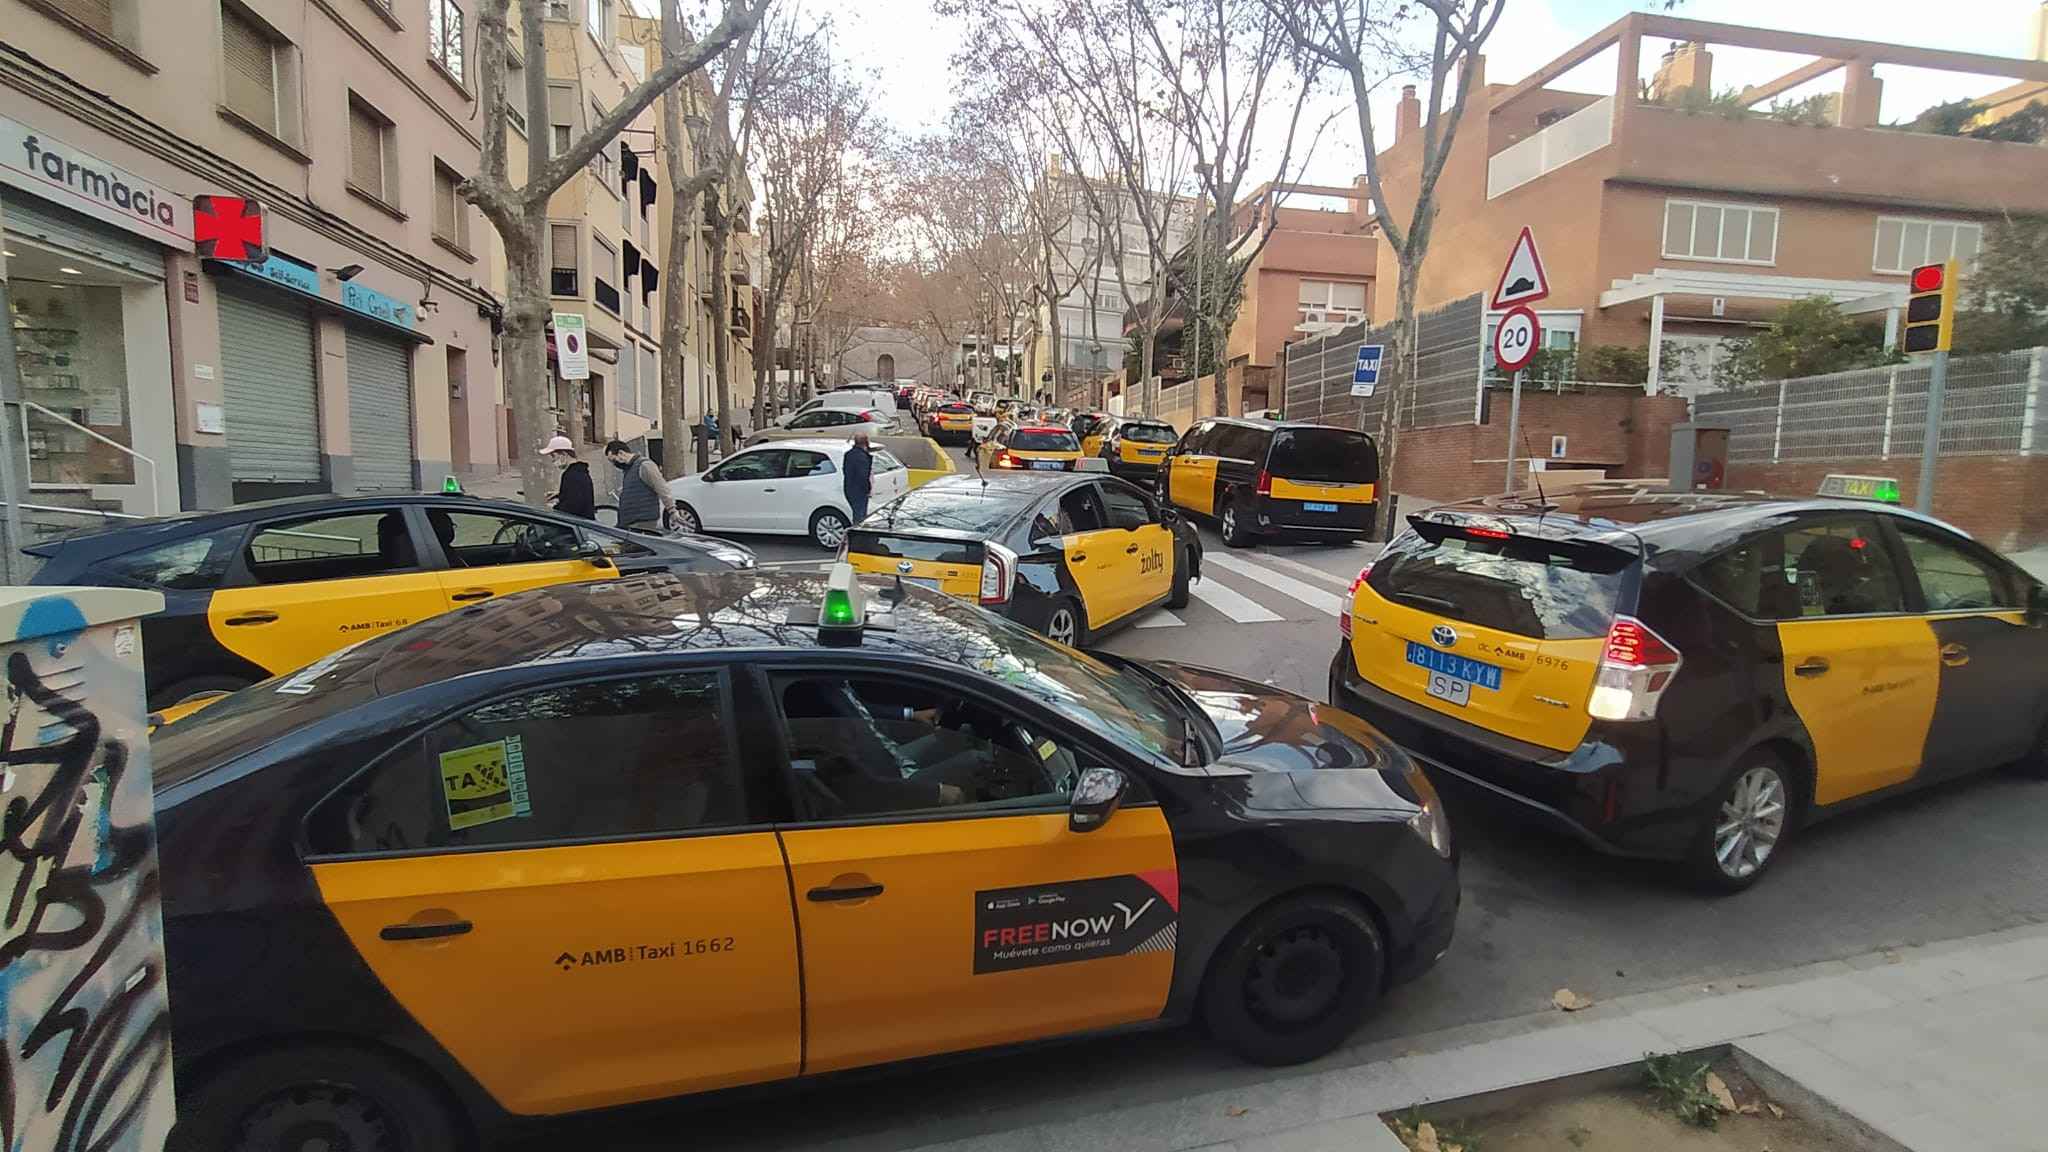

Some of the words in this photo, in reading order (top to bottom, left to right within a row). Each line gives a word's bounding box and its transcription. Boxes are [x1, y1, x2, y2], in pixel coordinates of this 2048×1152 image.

[23, 135, 174, 227] farmàcia
[1504, 327, 1528, 348] 20
[1358, 359, 1379, 371] TAXI
[1844, 480, 1876, 497] TAXI
[350, 622, 371, 631] AMB
[375, 620, 393, 628] Taxi
[1416, 646, 1457, 674] 8113
[1462, 662, 1498, 687] KYW
[1505, 649, 1526, 660] AMB
[1536, 655, 1569, 671] 6976
[1433, 676, 1464, 697] SP
[445, 761, 508, 792] TAXI
[581, 948, 626, 966] AMB
[637, 942, 675, 960] Taxi
[684, 936, 734, 955] 1662
[993, 947, 1039, 961] Muévete
[1041, 943, 1071, 955] como
[1074, 937, 1112, 951] quieras
